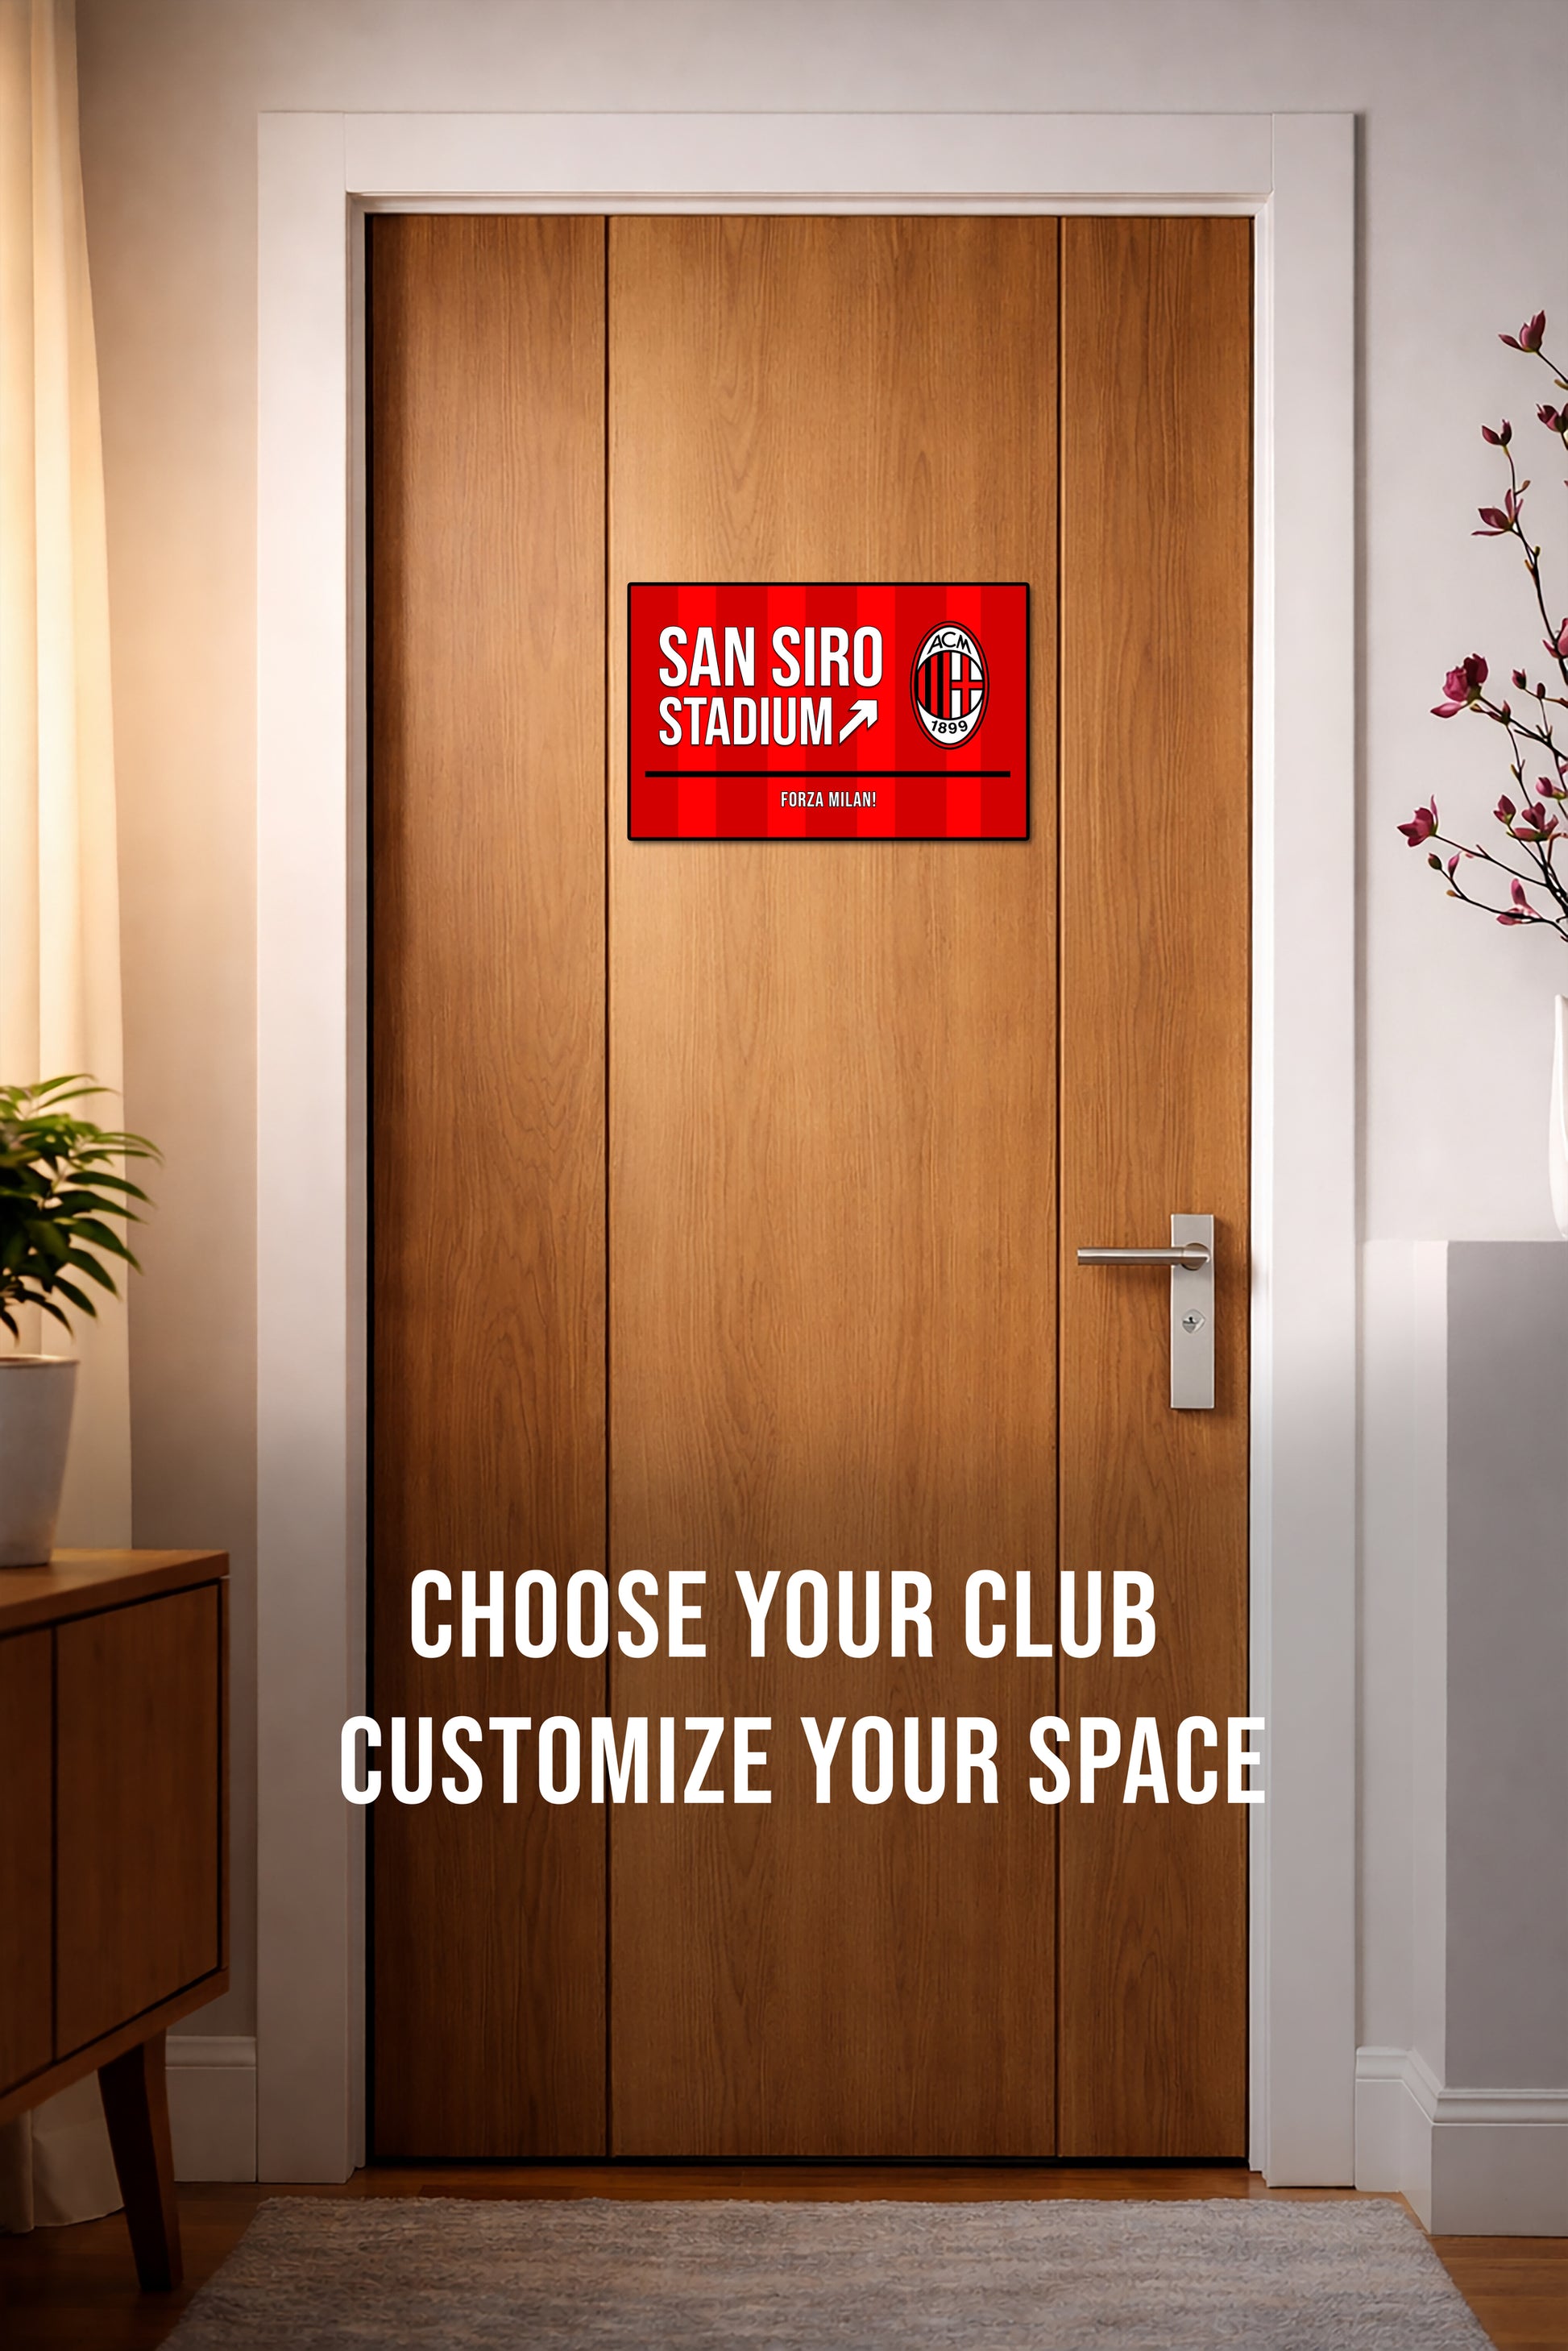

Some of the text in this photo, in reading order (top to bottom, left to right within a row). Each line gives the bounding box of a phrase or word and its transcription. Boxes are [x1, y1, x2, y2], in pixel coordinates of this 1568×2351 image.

[927, 631, 972, 654] ACM
[660, 627, 881, 686] SAN SIRO
[660, 697, 832, 745] STADIUM
[930, 720, 968, 734] 1899
[782, 792, 875, 806] FORZA MILAN!
